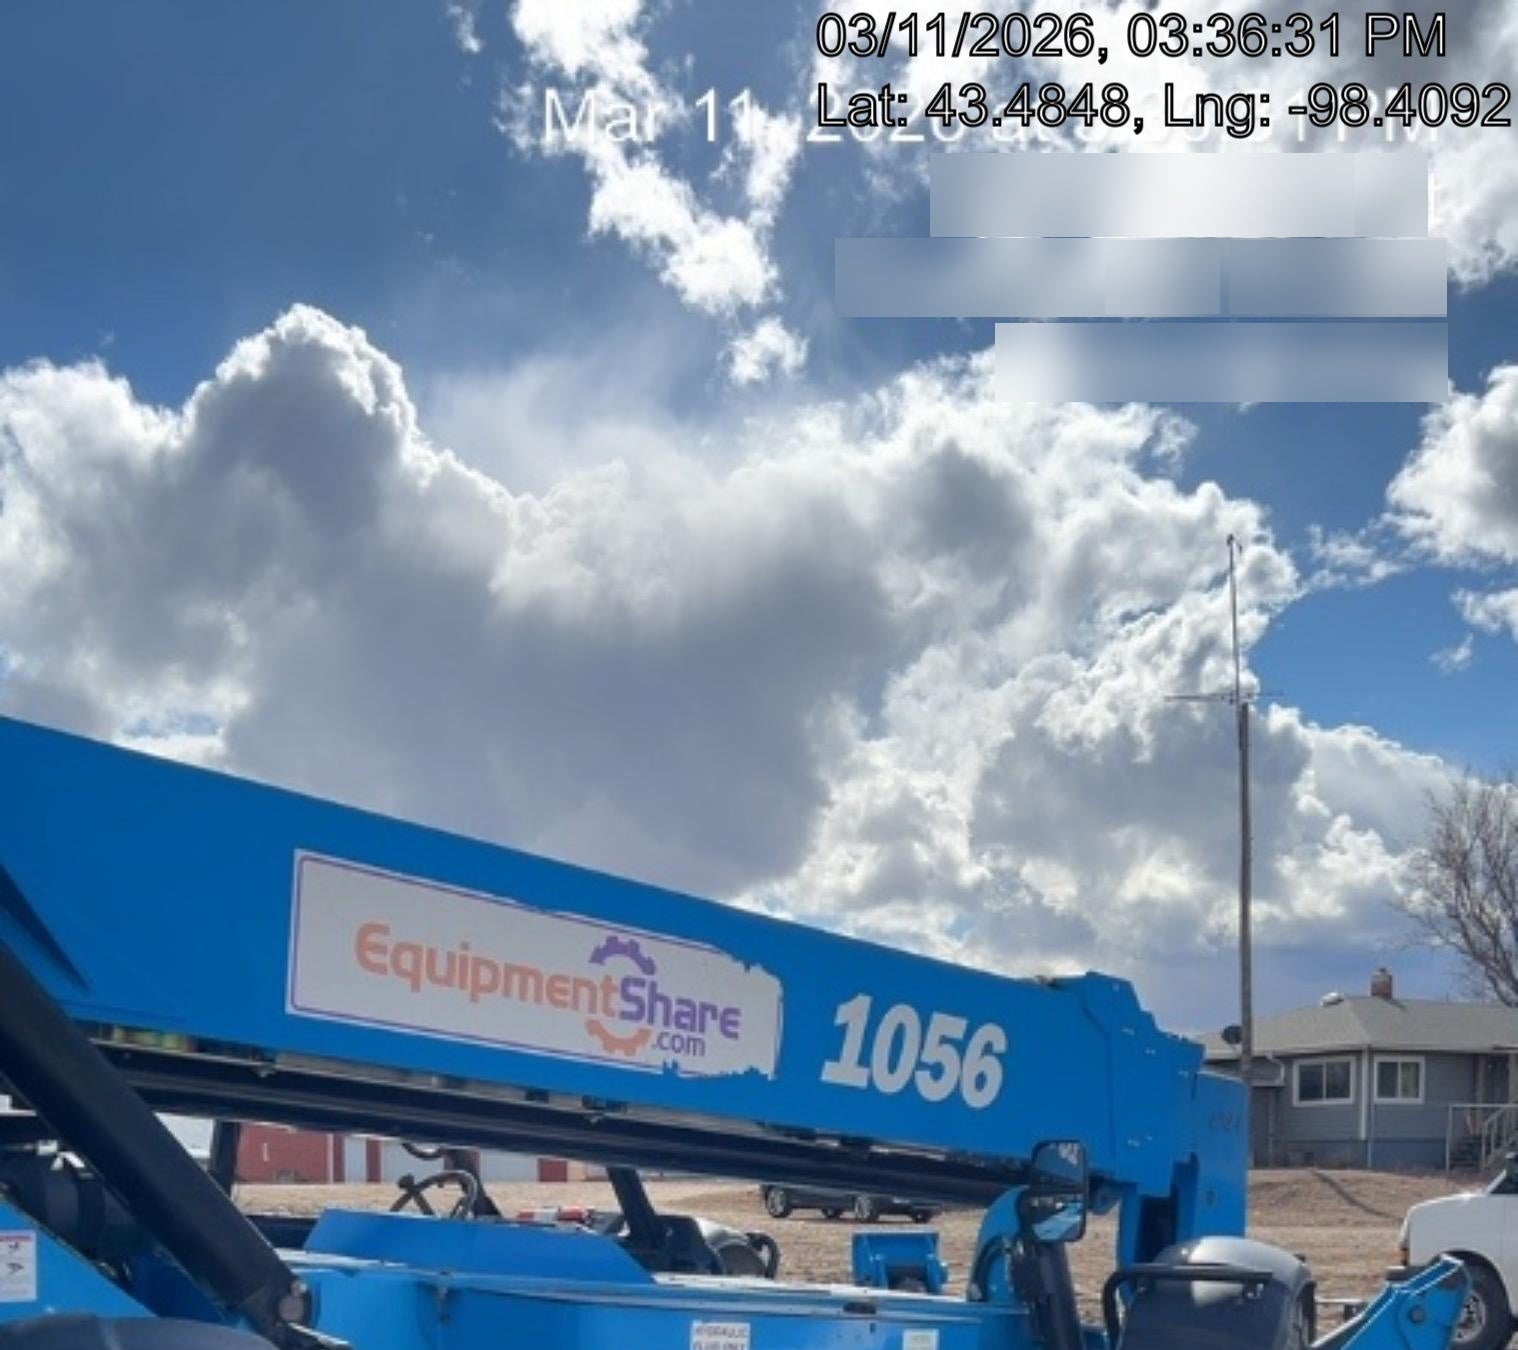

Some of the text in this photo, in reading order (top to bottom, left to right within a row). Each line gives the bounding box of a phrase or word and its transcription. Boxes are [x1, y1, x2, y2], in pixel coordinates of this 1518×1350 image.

[354, 922, 742, 1039] EquipmentShare
[652, 1029, 706, 1057] .com
[821, 993, 1007, 1109] 1056
